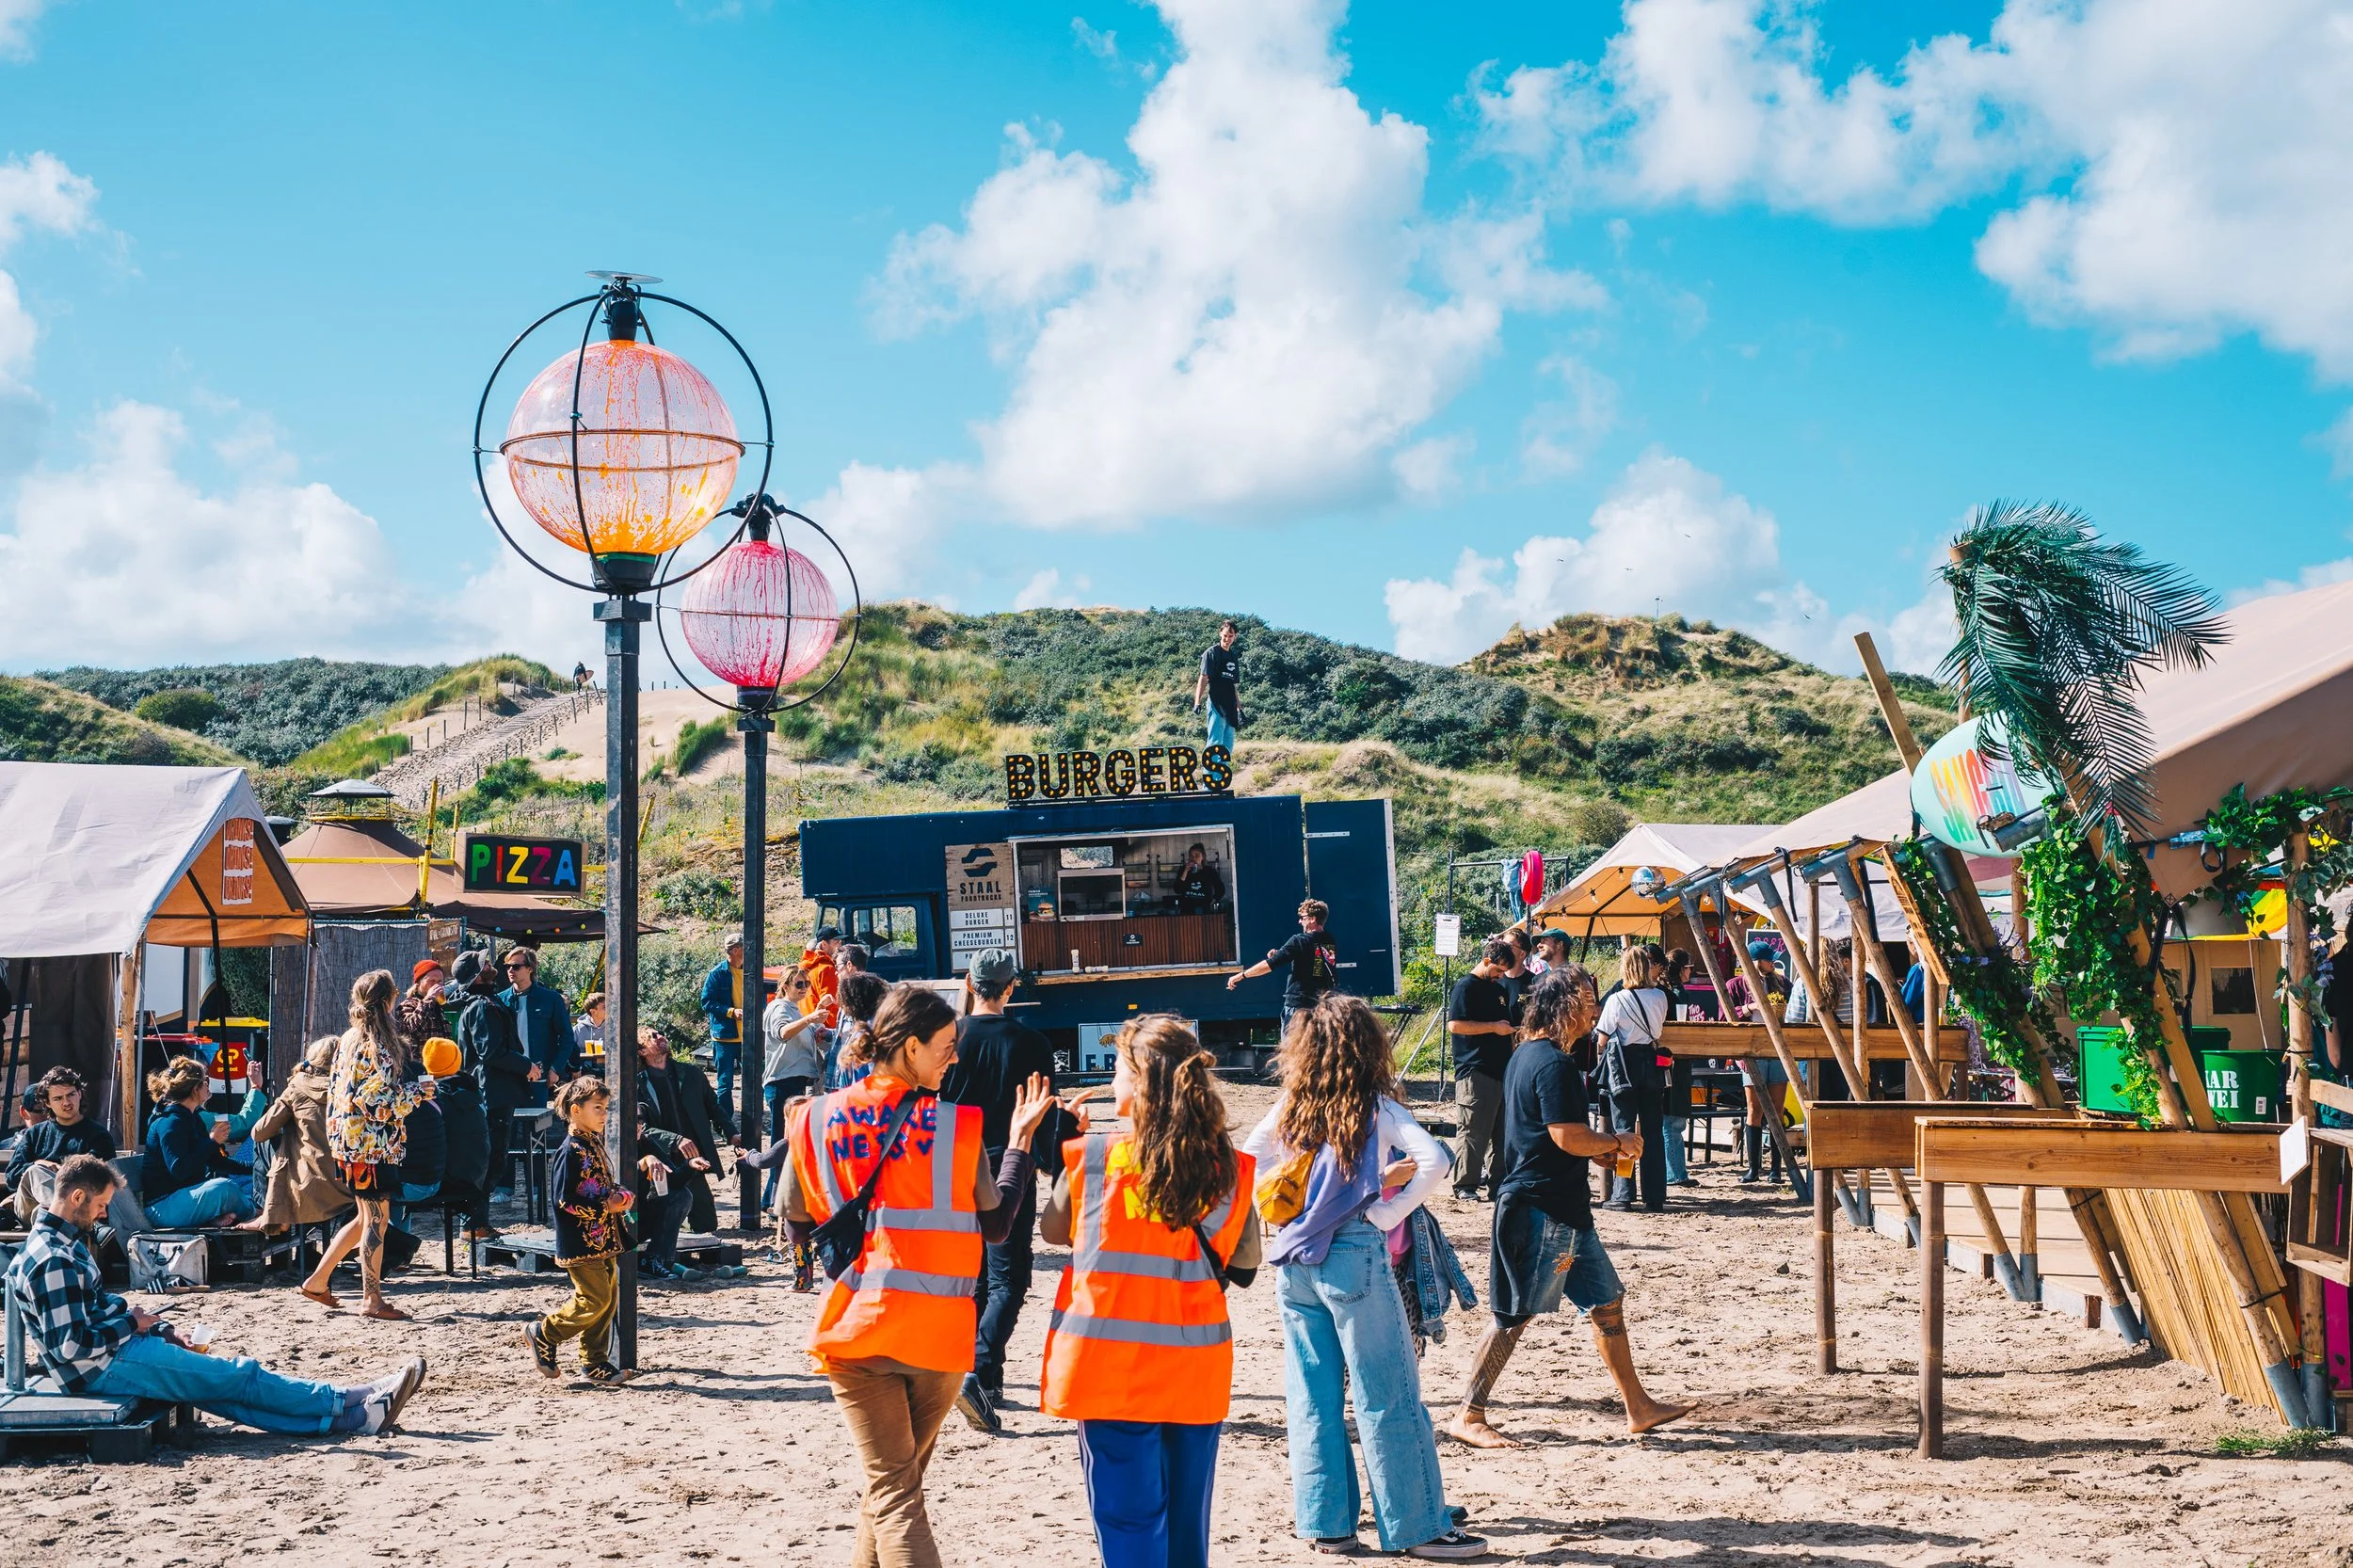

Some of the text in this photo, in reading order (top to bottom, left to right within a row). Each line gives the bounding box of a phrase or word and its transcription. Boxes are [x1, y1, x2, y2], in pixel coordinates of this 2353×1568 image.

[1006, 744, 1234, 800] BURGERS
[472, 843, 577, 887] PIZZA
[960, 881, 1001, 894] STAAL
[953, 938, 1002, 947] CHEESEBURGER
